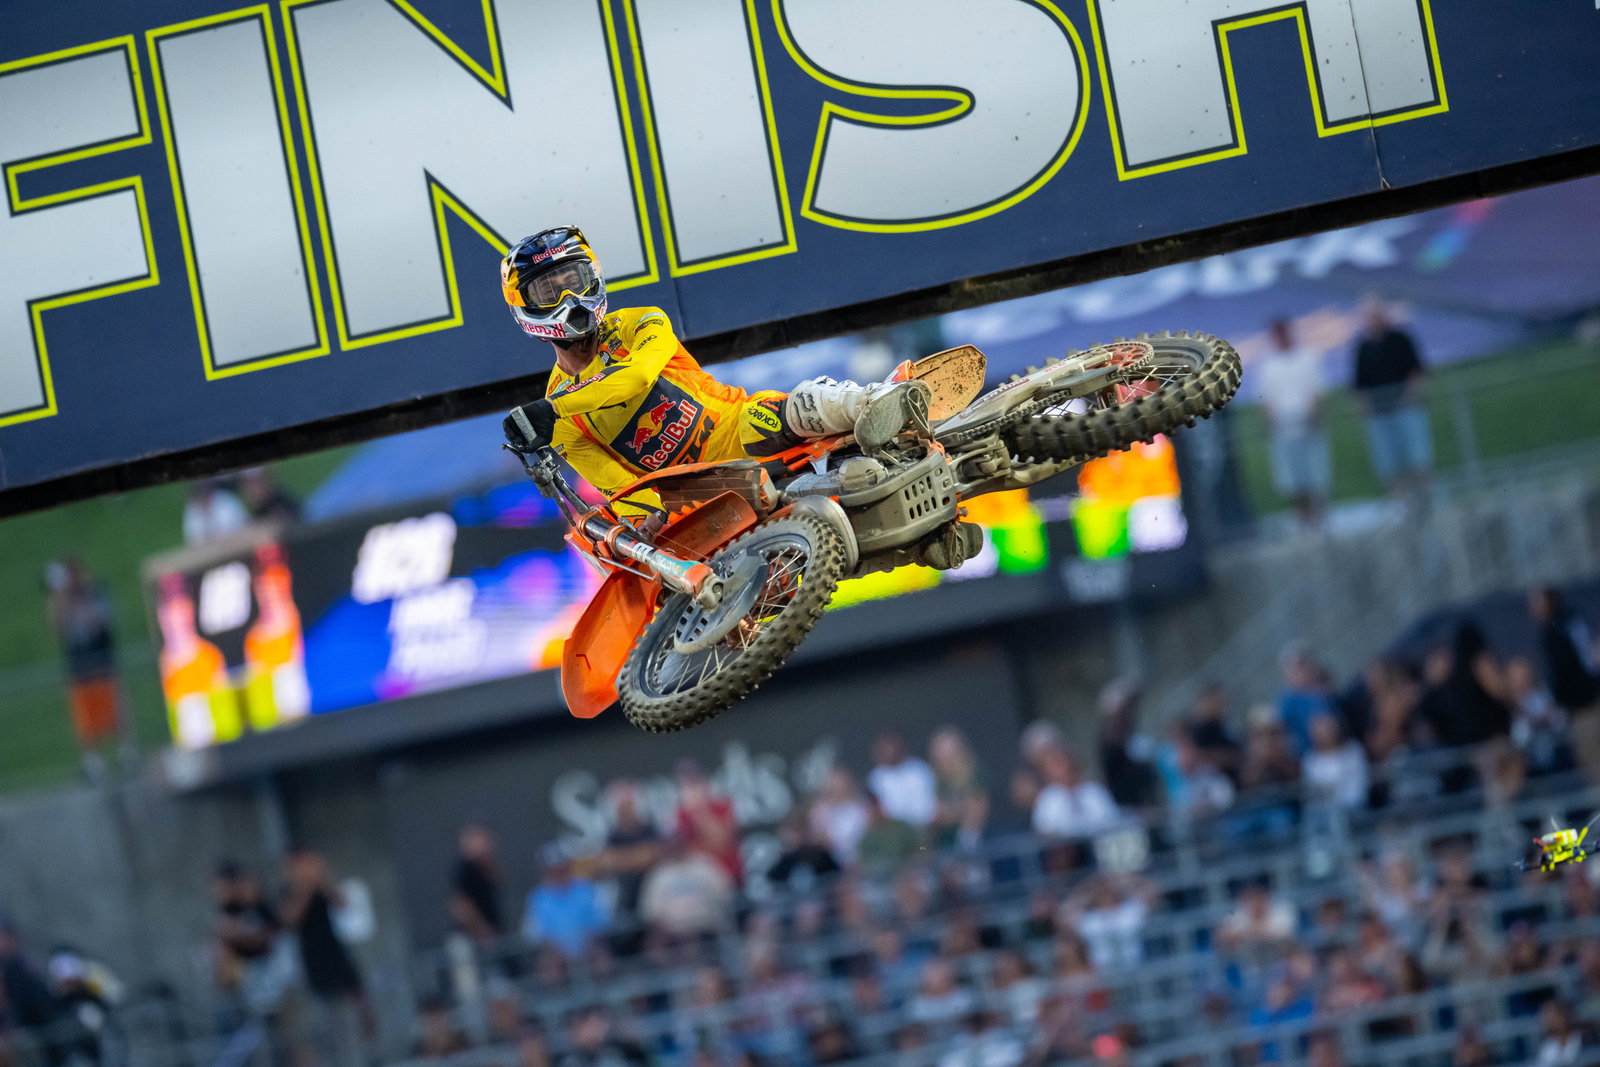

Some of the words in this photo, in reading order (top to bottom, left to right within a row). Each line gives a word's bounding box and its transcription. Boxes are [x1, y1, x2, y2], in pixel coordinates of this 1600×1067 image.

[532, 250, 551, 264] Red
[551, 244, 567, 256] Bull
[763, 415, 779, 429] FOX
[639, 433, 678, 470] Red
[664, 399, 697, 442] Bull
